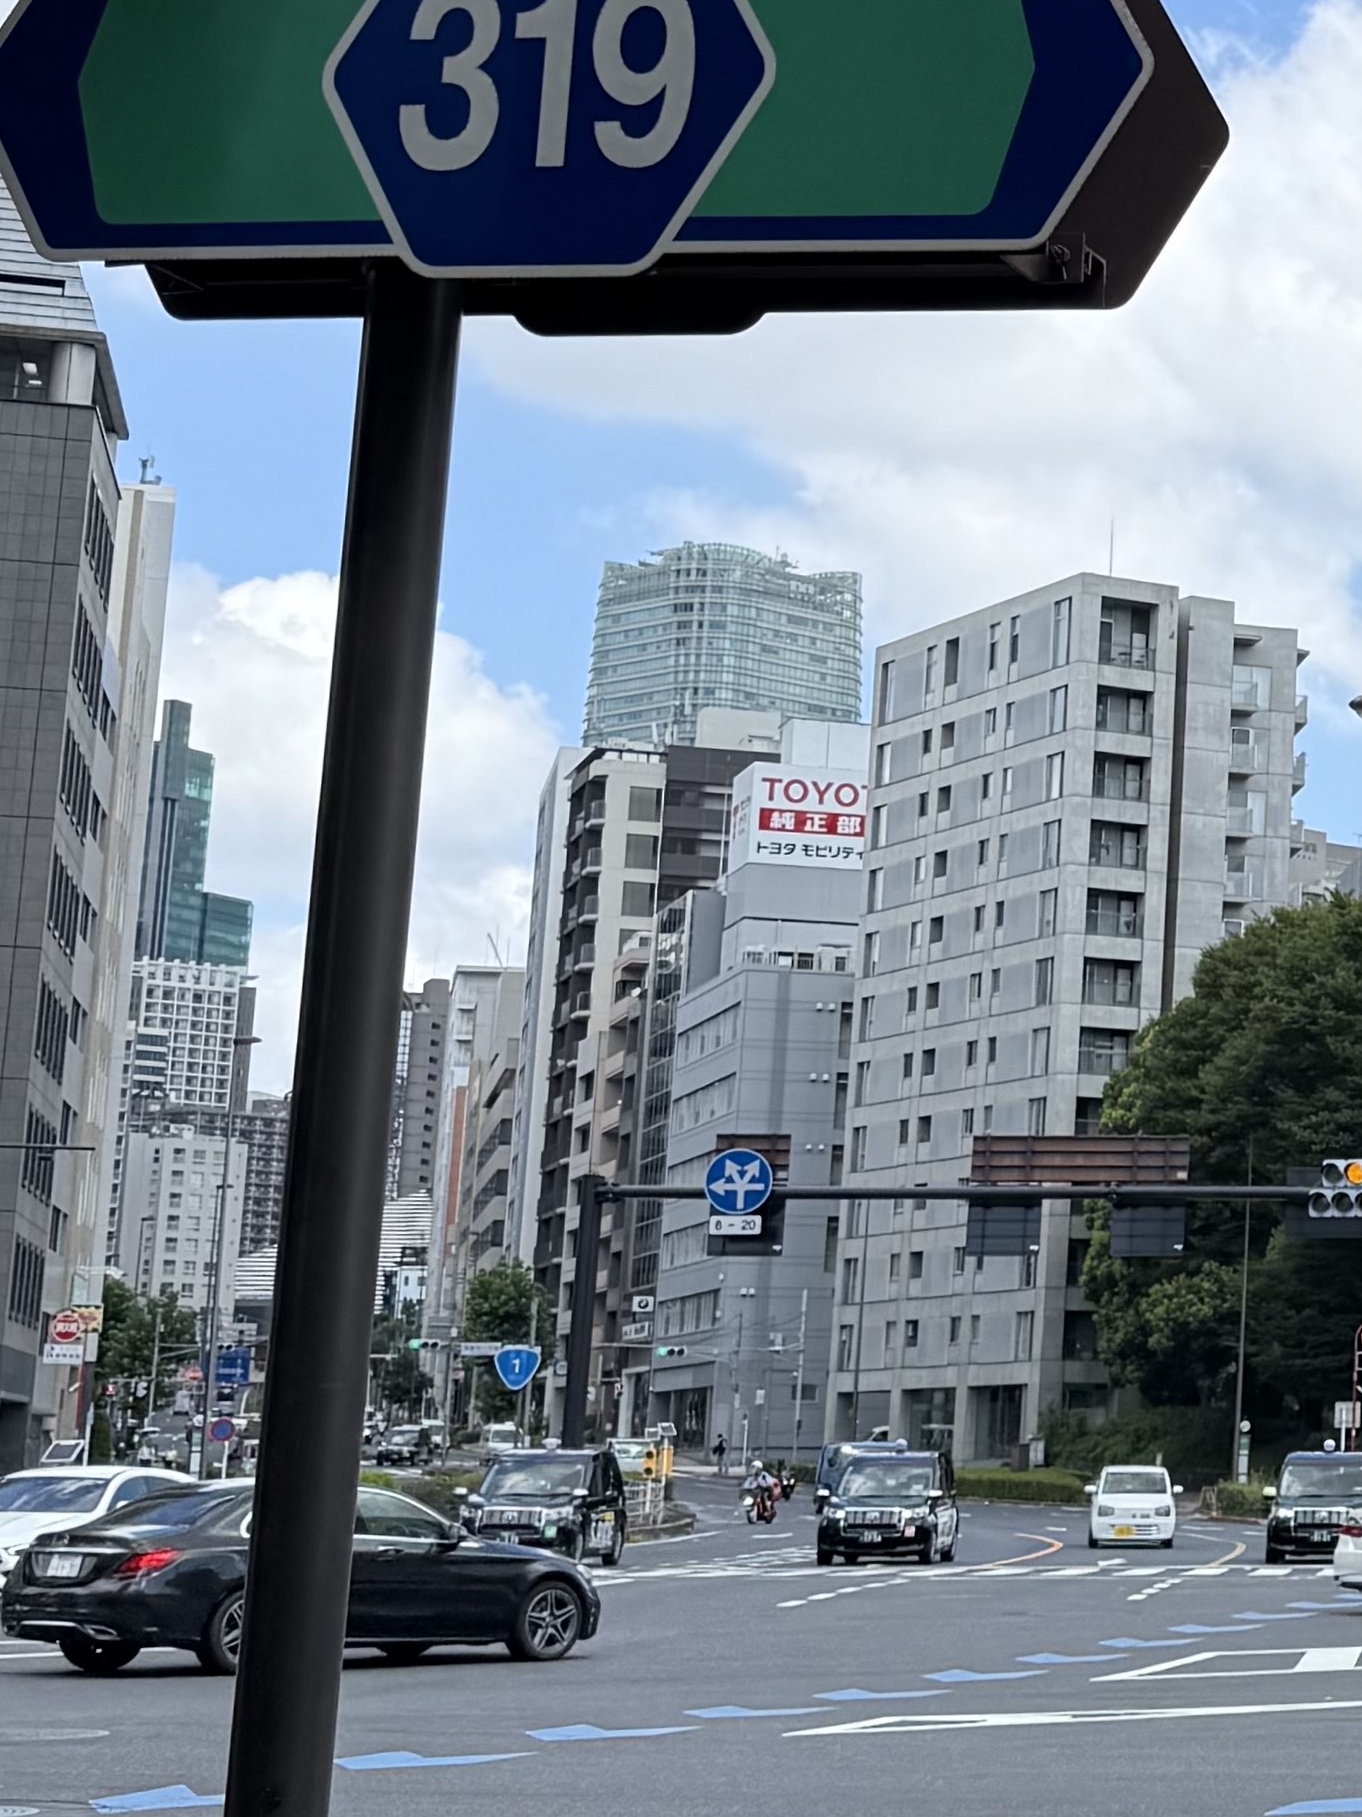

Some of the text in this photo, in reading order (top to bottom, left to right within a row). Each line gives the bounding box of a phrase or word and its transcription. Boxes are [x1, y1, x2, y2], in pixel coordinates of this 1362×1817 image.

[761, 777, 868, 808] TOYO
[769, 811, 862, 835] 純正部
[757, 841, 796, 855] トヨタ
[511, 1357, 520, 1373] 1
